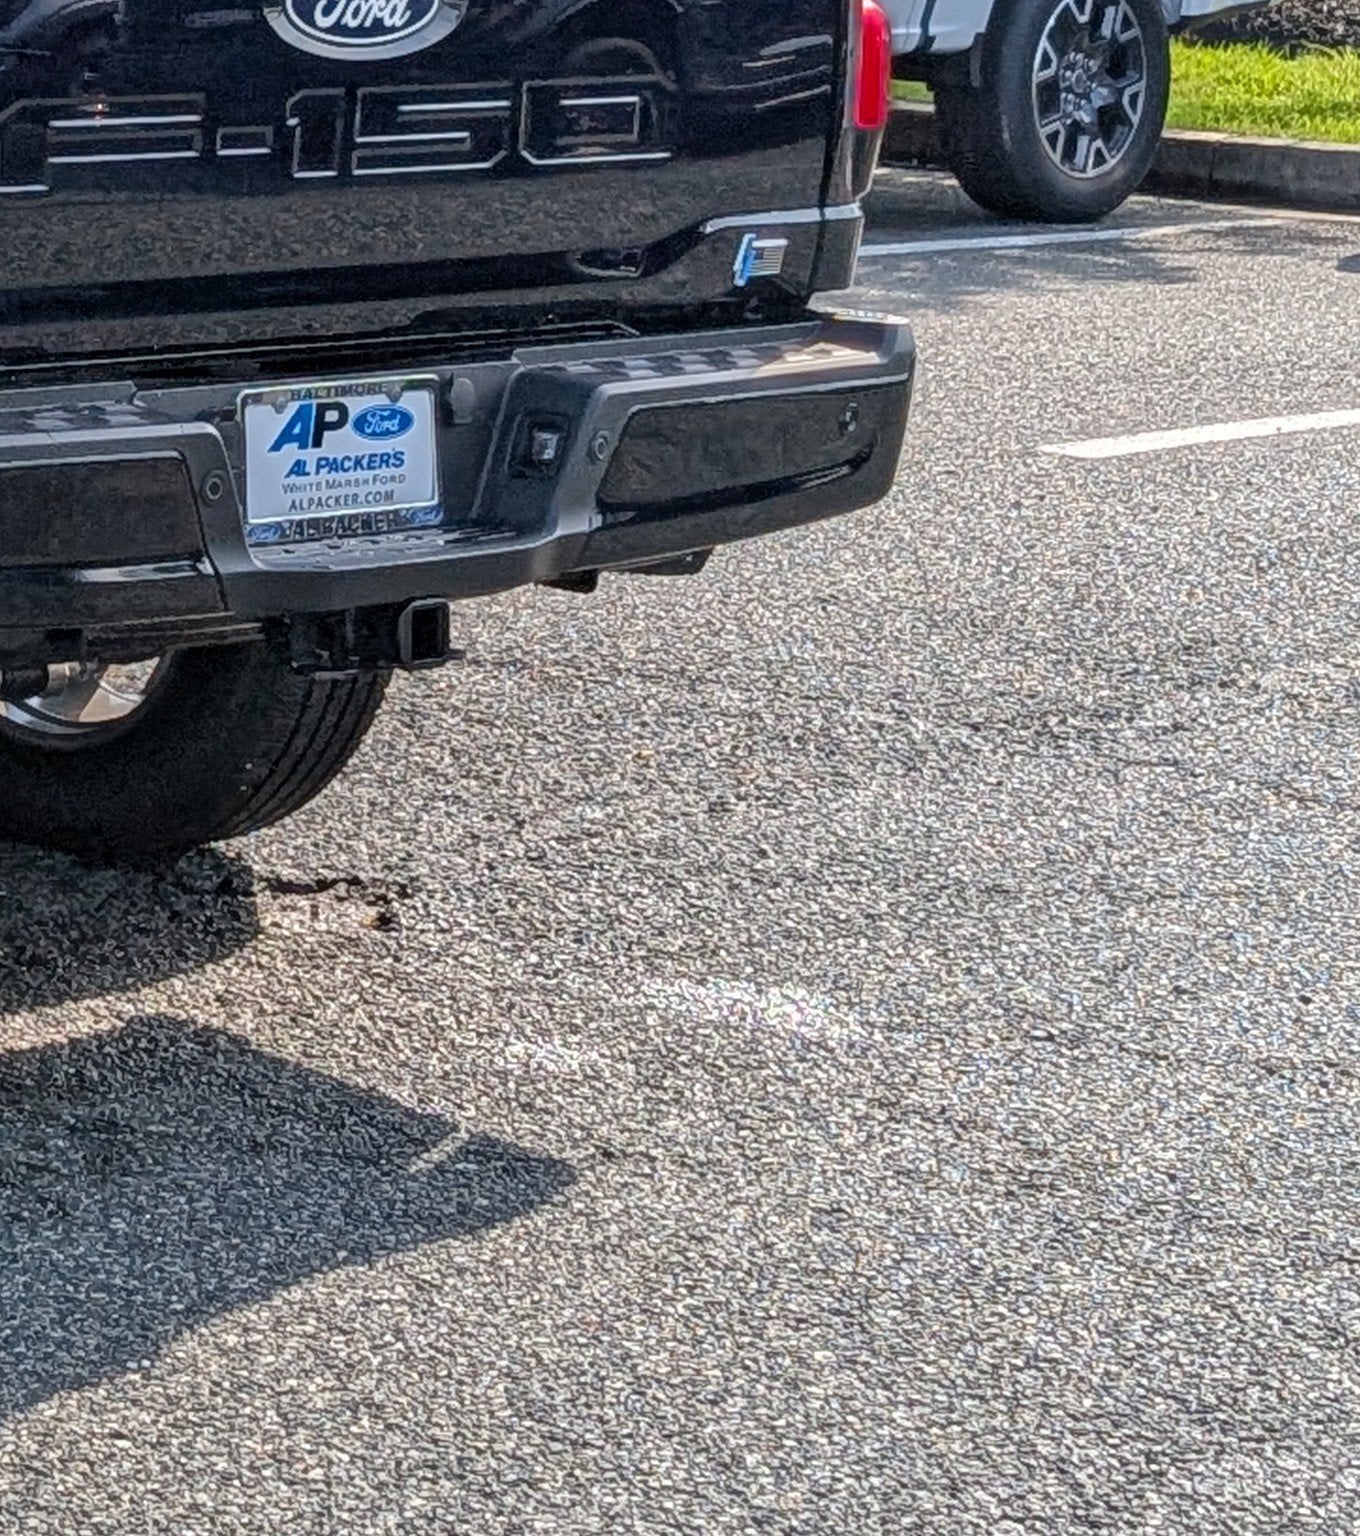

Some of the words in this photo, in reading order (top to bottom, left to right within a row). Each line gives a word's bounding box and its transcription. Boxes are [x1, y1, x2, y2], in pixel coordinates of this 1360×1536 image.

[291, 383, 389, 401] BALTIMORE
[267, 401, 350, 453] AP
[284, 458, 311, 479] AL
[288, 488, 395, 512] ALPACKER.COM
